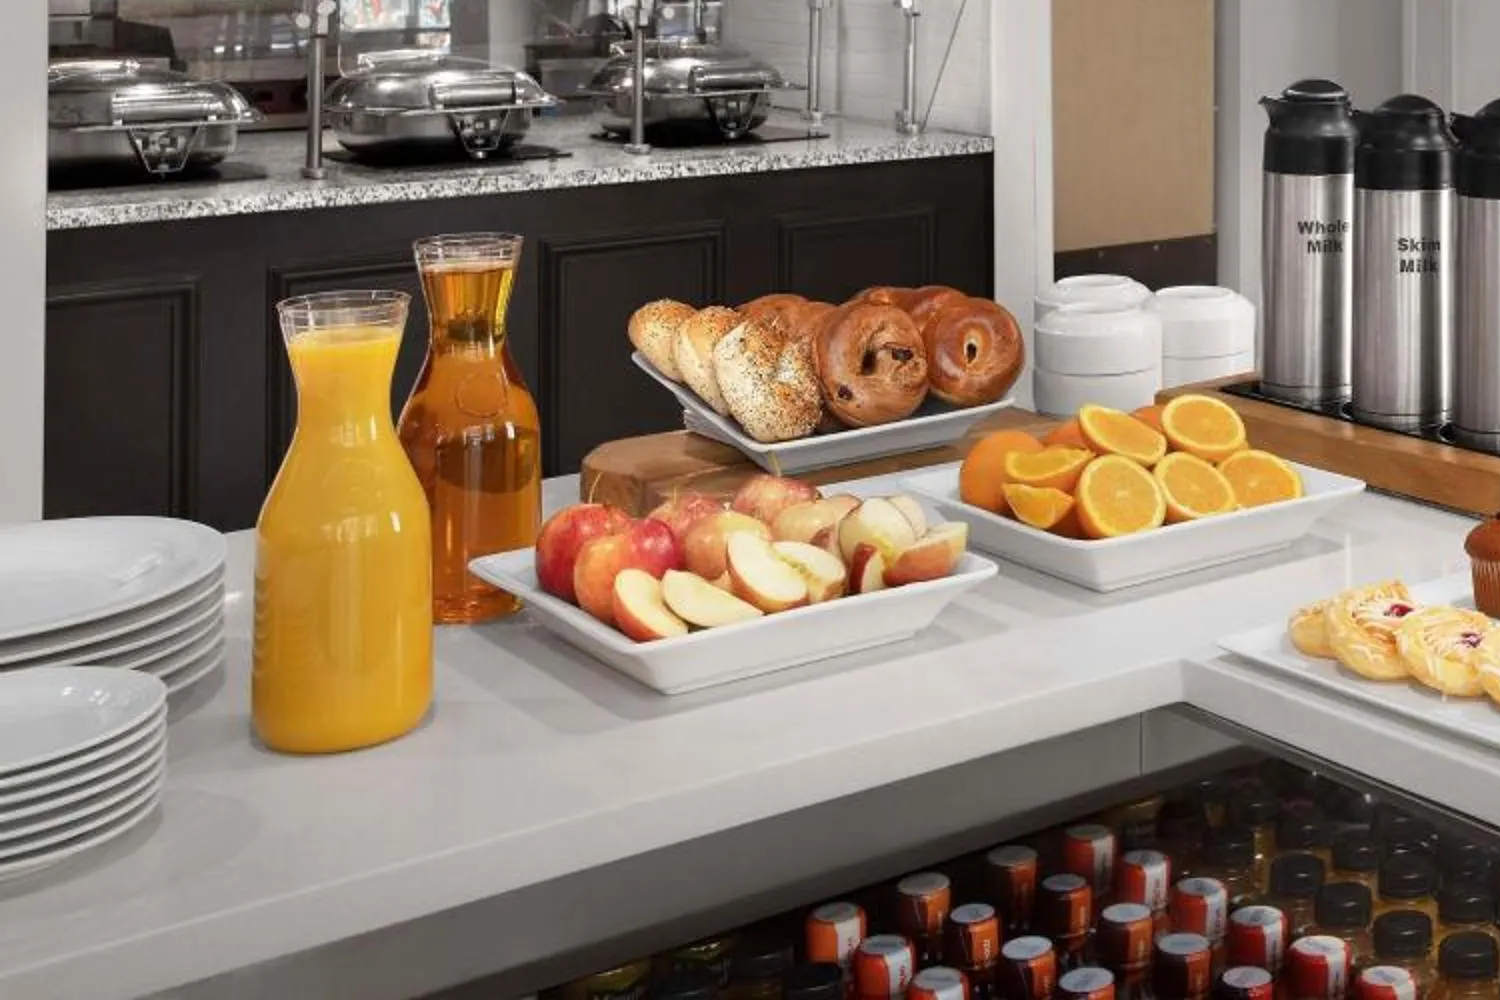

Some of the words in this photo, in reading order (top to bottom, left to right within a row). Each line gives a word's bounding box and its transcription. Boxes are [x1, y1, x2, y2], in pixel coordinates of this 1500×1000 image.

[1297, 219, 1349, 235] Whole
[1307, 238, 1344, 254] Milk
[1397, 236, 1441, 252] Skim
[1399, 256, 1439, 273] Milk
